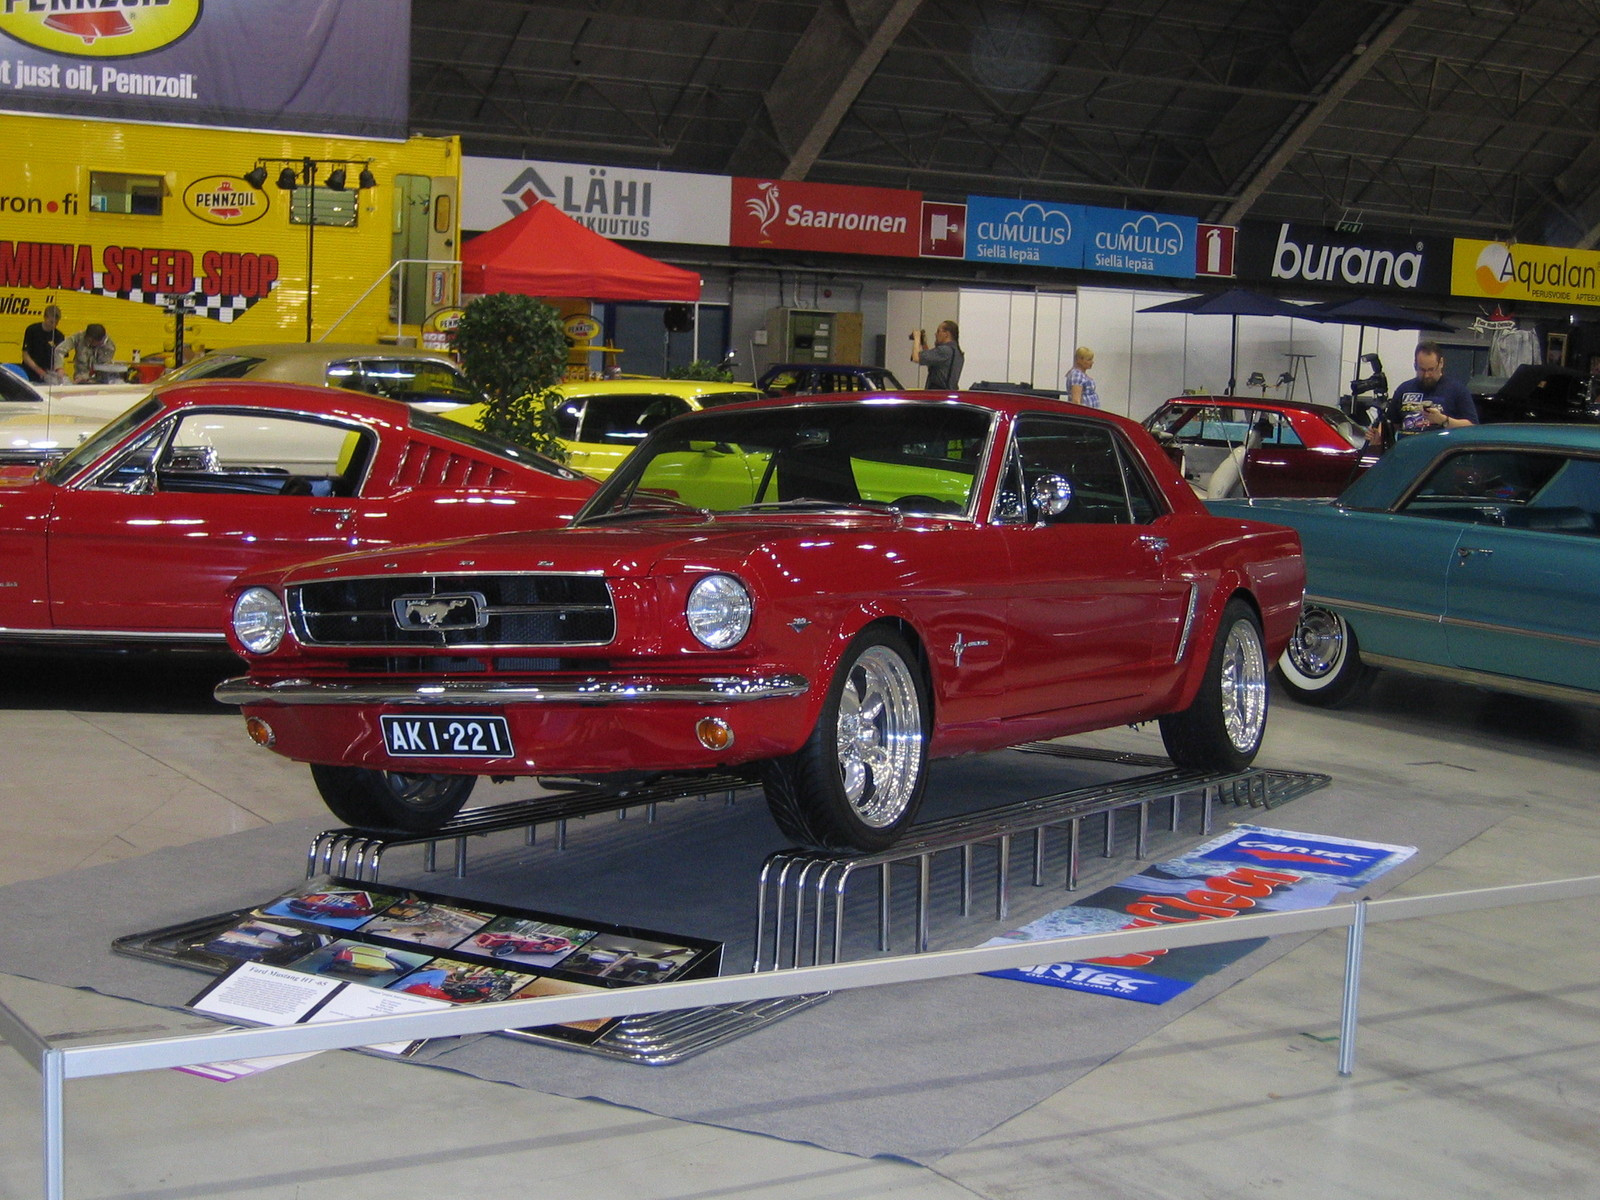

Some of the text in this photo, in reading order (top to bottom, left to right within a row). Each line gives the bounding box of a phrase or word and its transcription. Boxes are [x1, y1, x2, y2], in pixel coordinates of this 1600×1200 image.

[15, 60, 60, 89] just
[66, 65, 98, 95] oil,
[196, 192, 256, 207] PENNZOIL
[563, 168, 651, 218] LÄHI
[785, 204, 907, 233] Saarioinen
[977, 222, 1066, 246] CUMULUS
[1095, 231, 1178, 256] CUMULUS
[977, 244, 1040, 263] Siellä lepää
[1095, 253, 1154, 272] Siellä lepää
[0, 240, 279, 298] MUNA SPEED SHOP
[1500, 252, 1595, 292] Aqualan
[392, 721, 501, 751] AKI-221
[269, 969, 301, 982] Mustang
